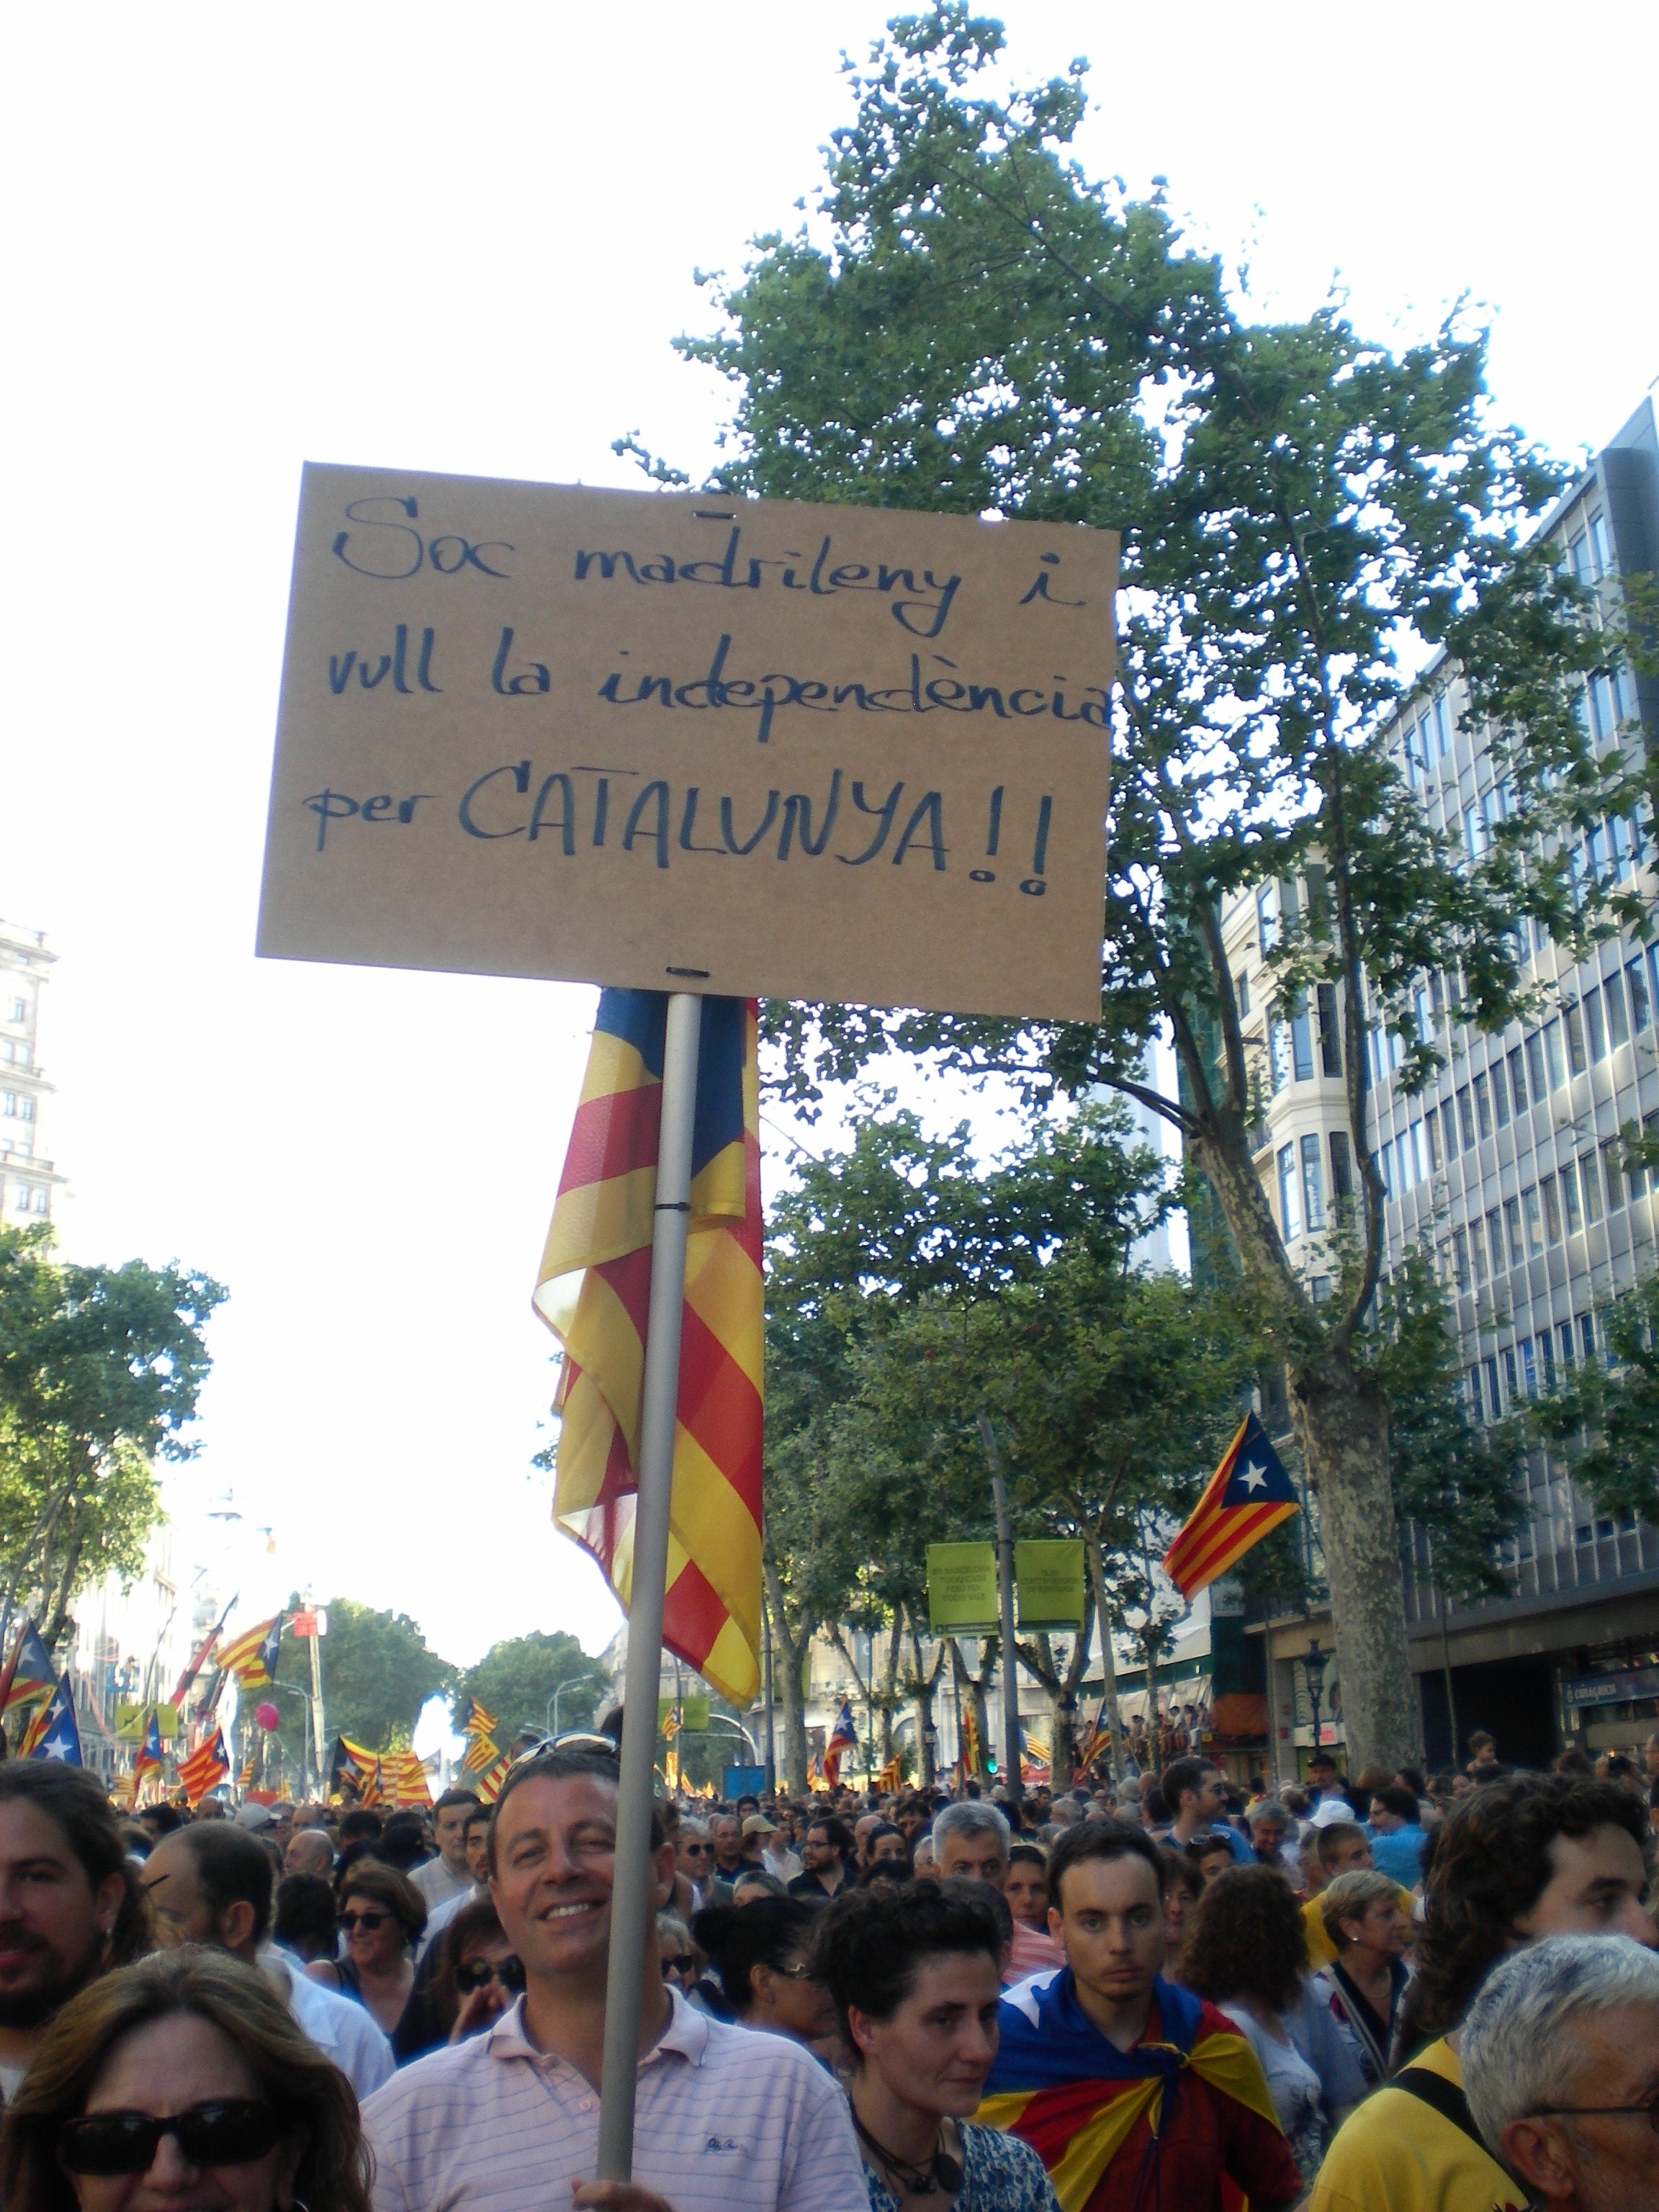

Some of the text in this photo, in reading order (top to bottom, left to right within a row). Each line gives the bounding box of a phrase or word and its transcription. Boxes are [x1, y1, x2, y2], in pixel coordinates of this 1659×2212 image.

[333, 496, 1087, 637] Soc madrileny i
[329, 624, 1112, 742] vull la independència
[302, 787, 439, 852] per
